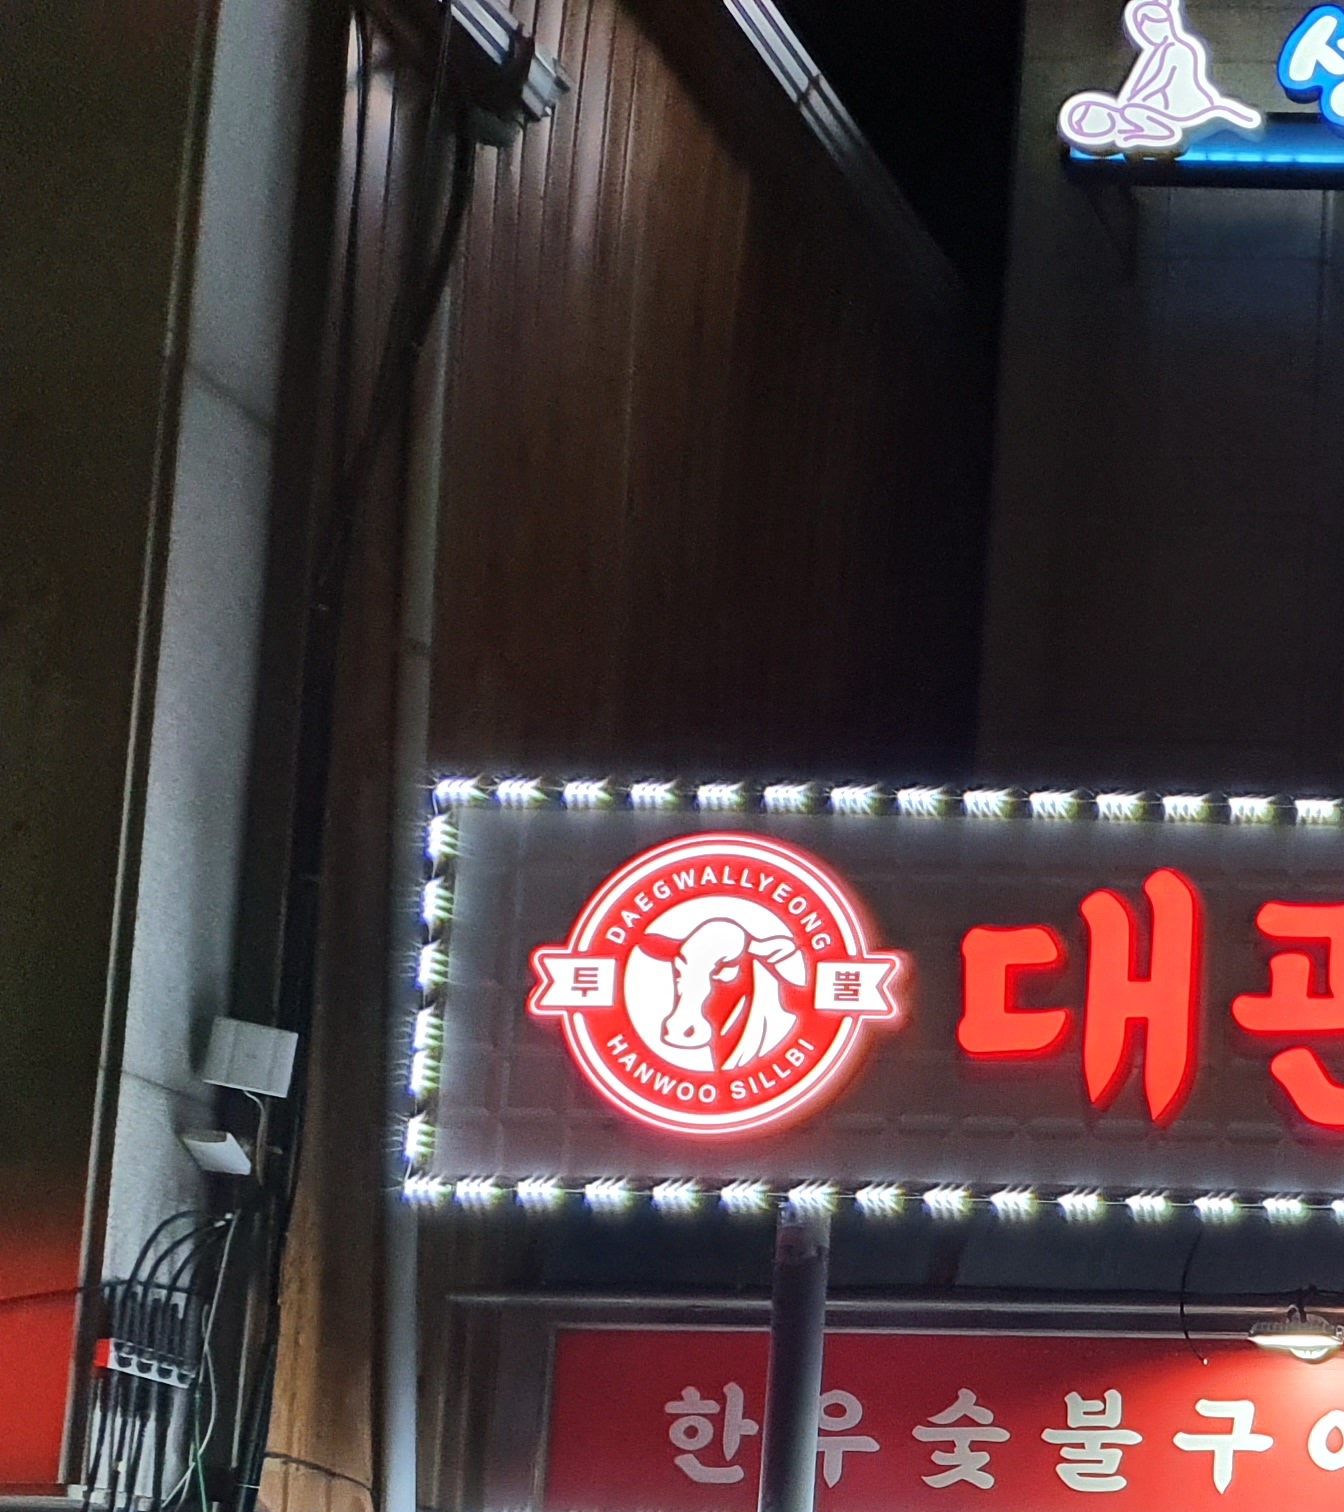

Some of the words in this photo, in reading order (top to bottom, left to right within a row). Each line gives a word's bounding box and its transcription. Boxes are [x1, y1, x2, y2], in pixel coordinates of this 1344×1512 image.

[606, 865, 832, 952] DAEGWALLYEONG
[570, 966, 600, 998] 투
[606, 1033, 717, 1104] HANWOO
[730, 1036, 816, 1100] SILLBI
